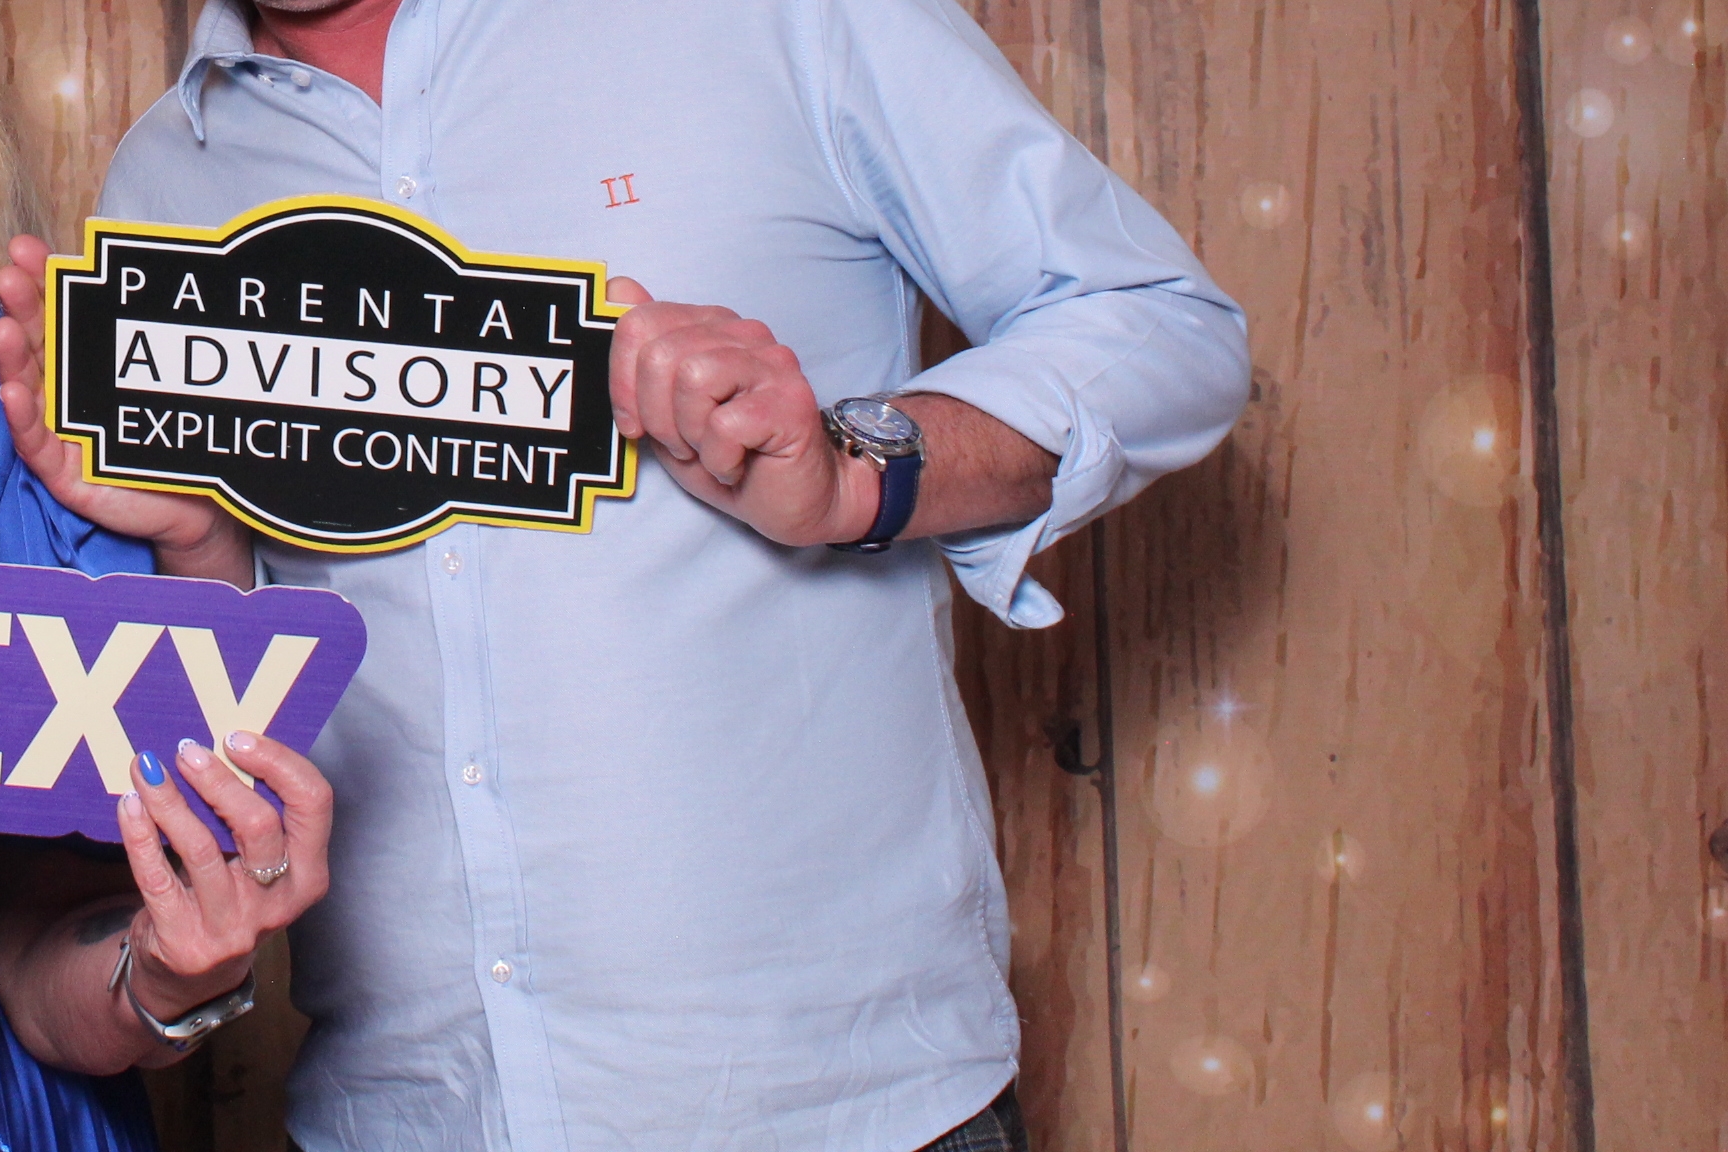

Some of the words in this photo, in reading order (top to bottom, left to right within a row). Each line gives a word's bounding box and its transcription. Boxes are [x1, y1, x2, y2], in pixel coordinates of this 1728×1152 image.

[119, 267, 573, 345] PARENTAL
[118, 330, 570, 419] ADVISORY
[117, 406, 320, 462] EXPLICIT
[333, 429, 568, 486] CONTENT
